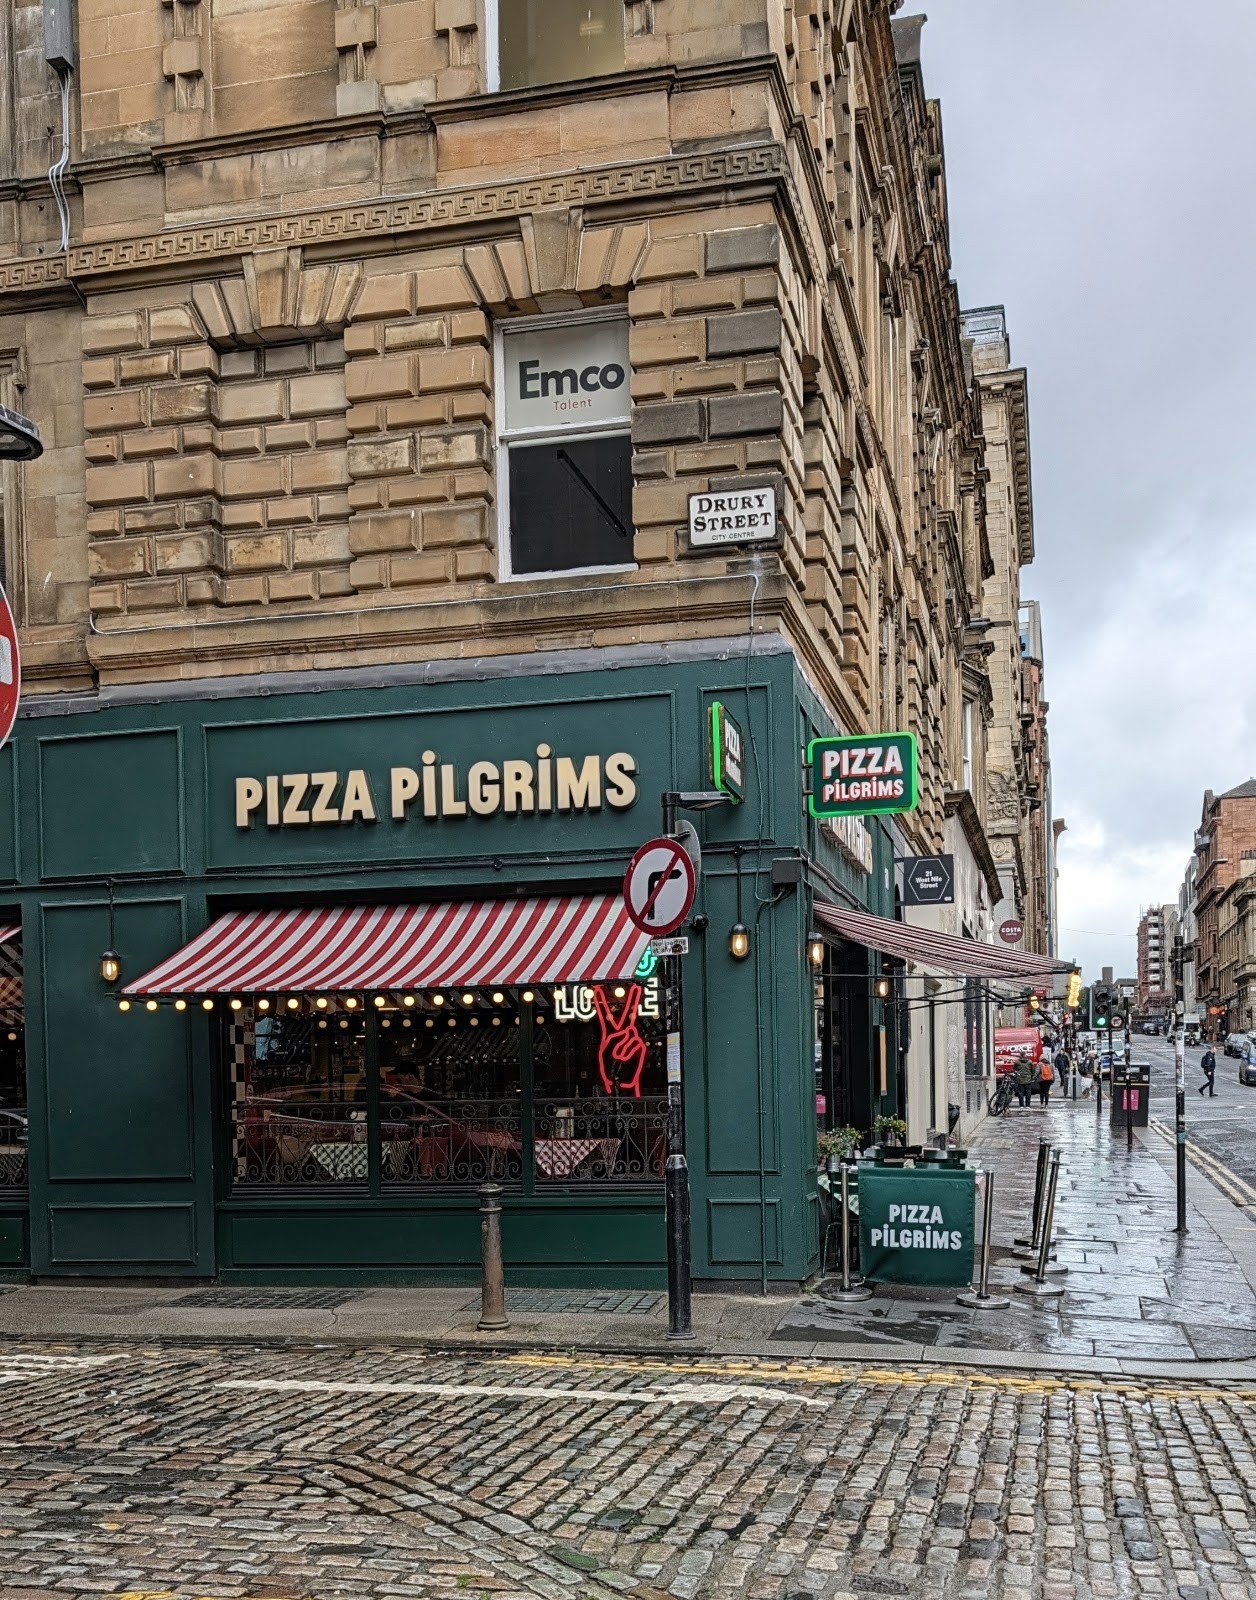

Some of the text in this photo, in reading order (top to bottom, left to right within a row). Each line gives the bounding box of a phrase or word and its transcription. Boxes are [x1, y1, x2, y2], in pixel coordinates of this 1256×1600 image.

[519, 360, 625, 400] Emco
[553, 398, 592, 411] Talent
[697, 493, 767, 514] DRURY
[694, 512, 772, 533] STREET
[729, 531, 755, 540] CENTRE
[823, 746, 904, 779] PIZZA
[235, 768, 377, 829] PIZZA
[889, 1204, 943, 1224] PIZZA
